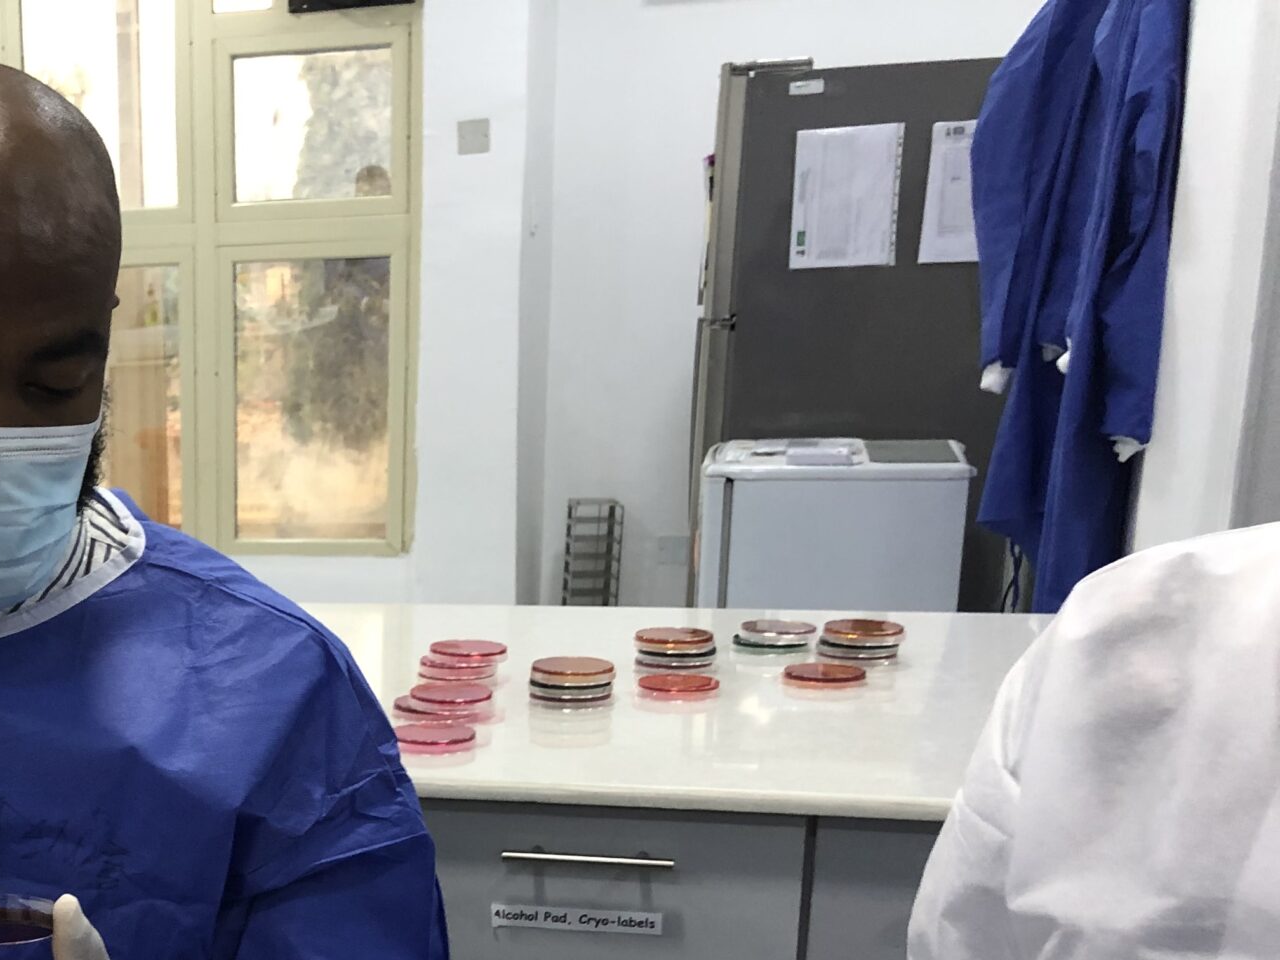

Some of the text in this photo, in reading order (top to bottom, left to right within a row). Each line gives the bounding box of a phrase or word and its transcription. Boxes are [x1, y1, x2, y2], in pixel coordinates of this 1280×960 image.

[494, 909, 656, 930] Alcohol Pad, Cryo-labels
